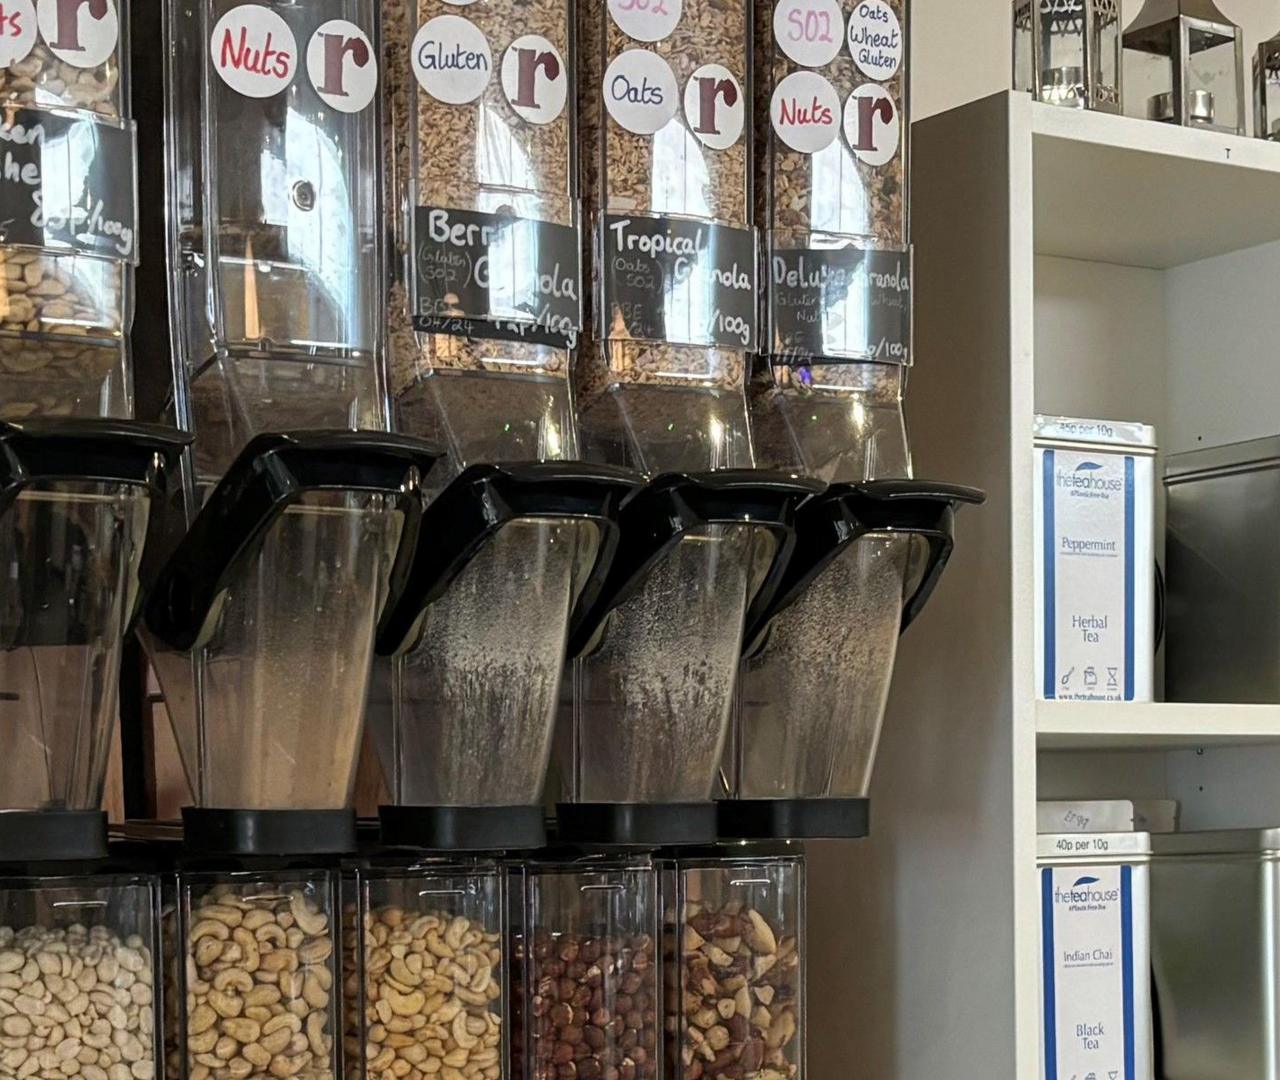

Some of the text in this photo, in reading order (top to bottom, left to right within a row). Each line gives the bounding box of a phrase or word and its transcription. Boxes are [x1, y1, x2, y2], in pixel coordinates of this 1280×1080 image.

[859, 4, 889, 24] Oats
[849, 24, 899, 49] Wheat
[220, 26, 291, 79] Nuts
[417, 40, 489, 72] Gluten
[858, 48, 897, 70] Gluten
[611, 74, 664, 105] Oats
[778, 95, 834, 126] Nuts
[609, 218, 702, 259] Tropical
[1057, 470, 1122, 492] theteahouse
[1061, 536, 1117, 552] Peppermint
[1072, 615, 1109, 629] Herbal
[1081, 629, 1100, 643] Tea
[1075, 840, 1090, 851] per
[1093, 839, 1109, 850] 10g
[1054, 885, 1119, 904] theteahouse
[1063, 949, 1113, 962] Indian Chai
[1076, 1023, 1105, 1037] Black
[1082, 1037, 1100, 1050] Tea
